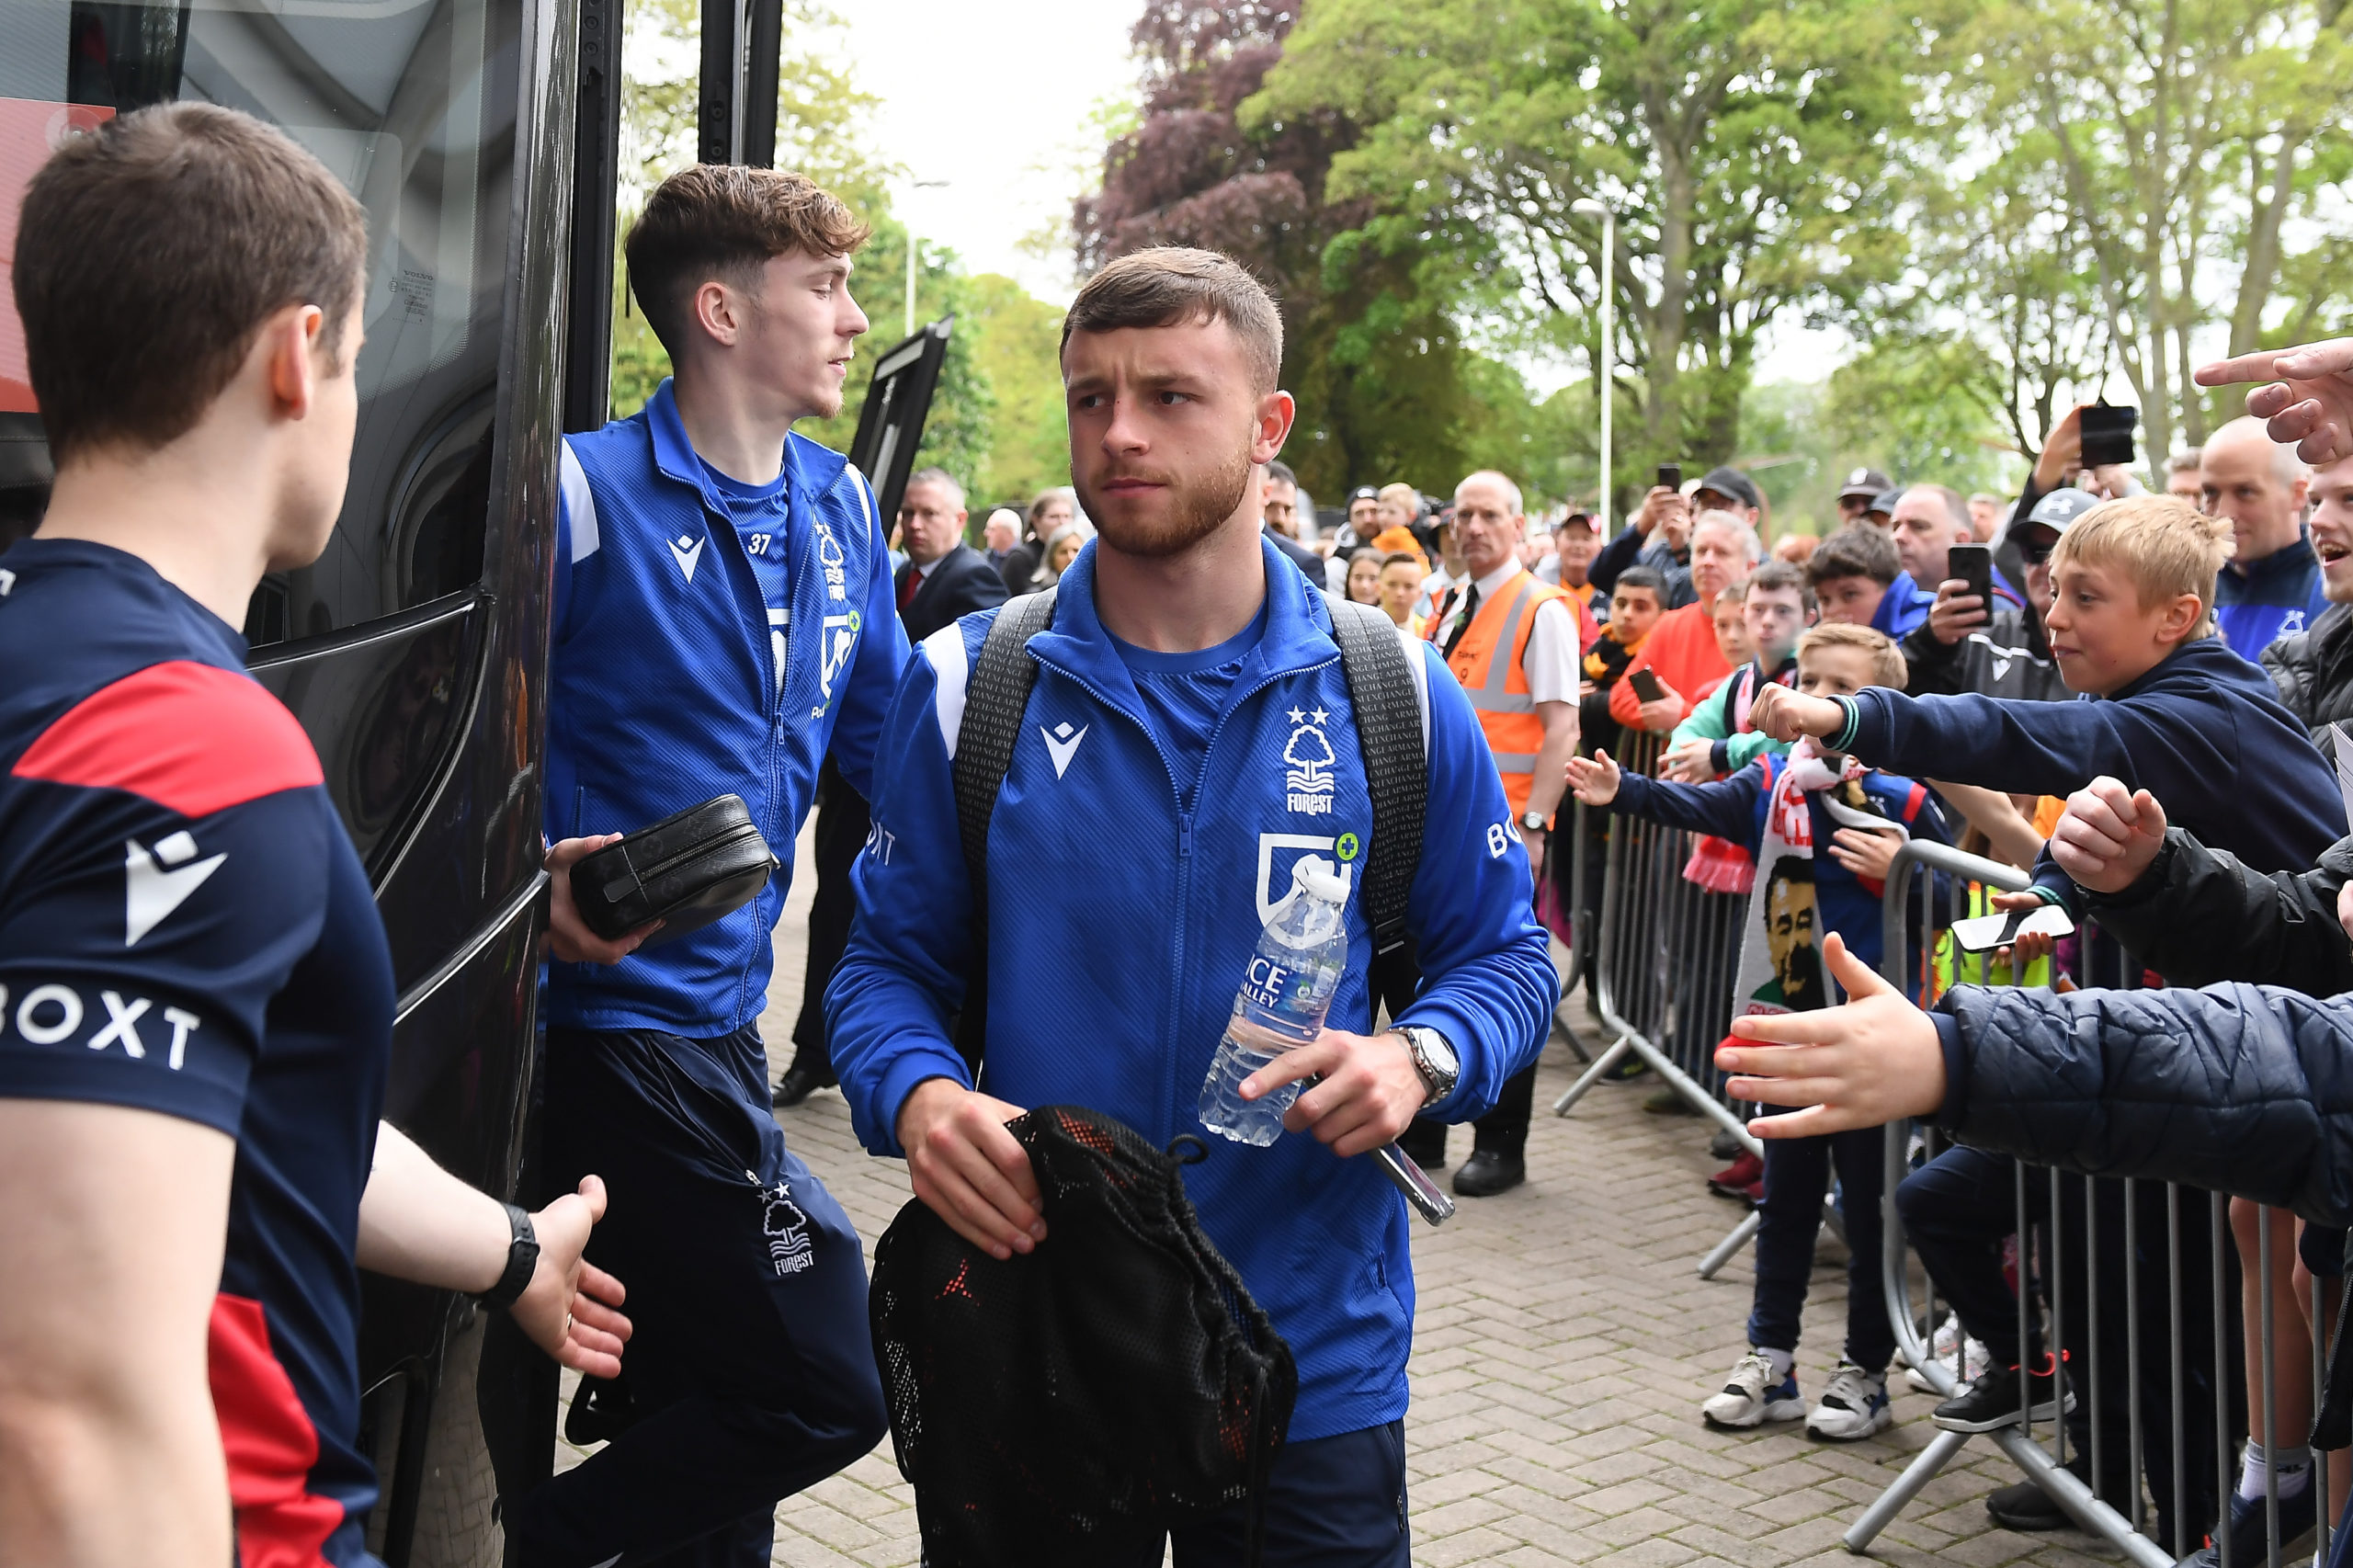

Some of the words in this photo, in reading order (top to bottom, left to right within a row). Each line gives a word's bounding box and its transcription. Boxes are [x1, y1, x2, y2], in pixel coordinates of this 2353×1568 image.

[748, 532, 772, 555] 37
[1245, 953, 1288, 994] ICE
[1240, 981, 1279, 1008] ALLEY
